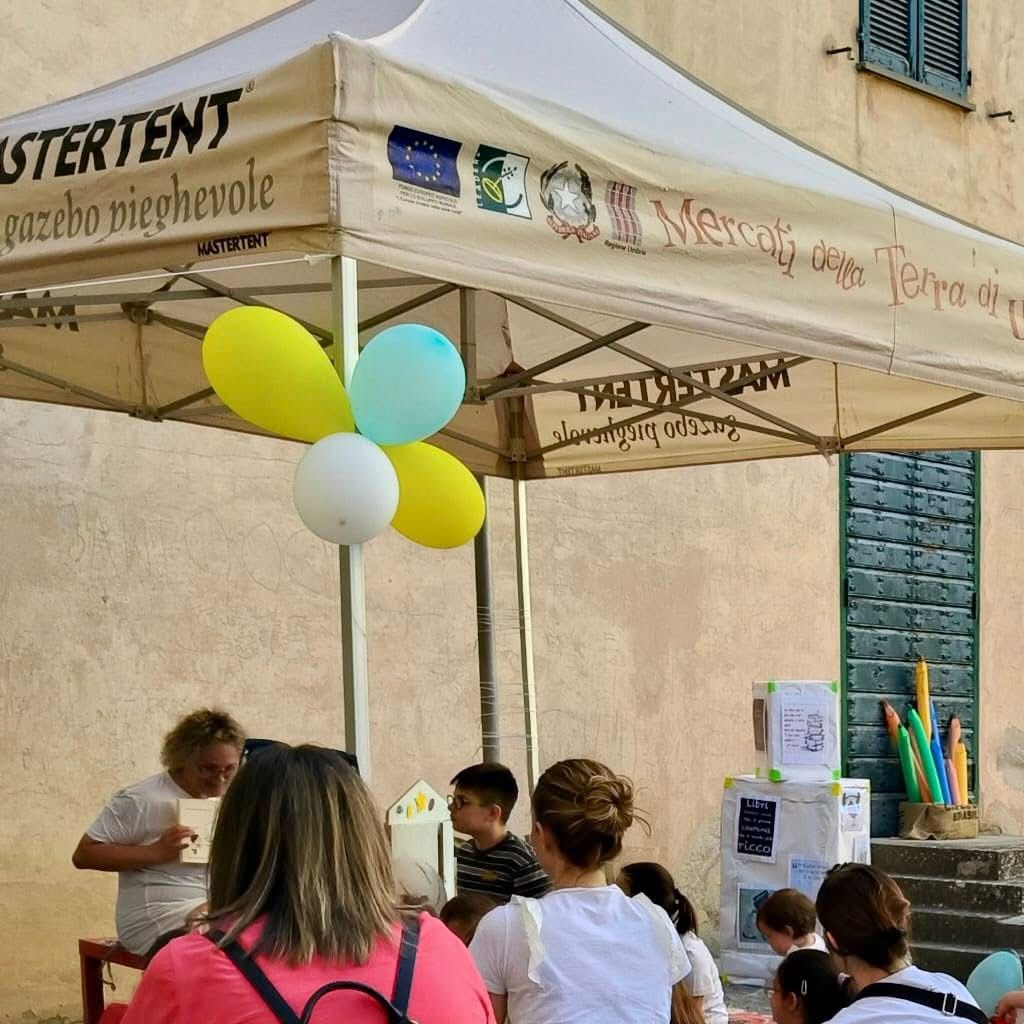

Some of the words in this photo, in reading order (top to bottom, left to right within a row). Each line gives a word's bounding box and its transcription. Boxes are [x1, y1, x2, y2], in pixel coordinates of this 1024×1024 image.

[0, 87, 243, 184] STERTENT
[4, 187, 101, 252] gazebo
[96, 157, 275, 244] pieghevole
[197, 233, 270, 257] MASTERTENT
[650, 197, 796, 279] Mercati
[812, 239, 866, 291] della
[874, 245, 967, 311] Terra
[978, 268, 1000, 319] di
